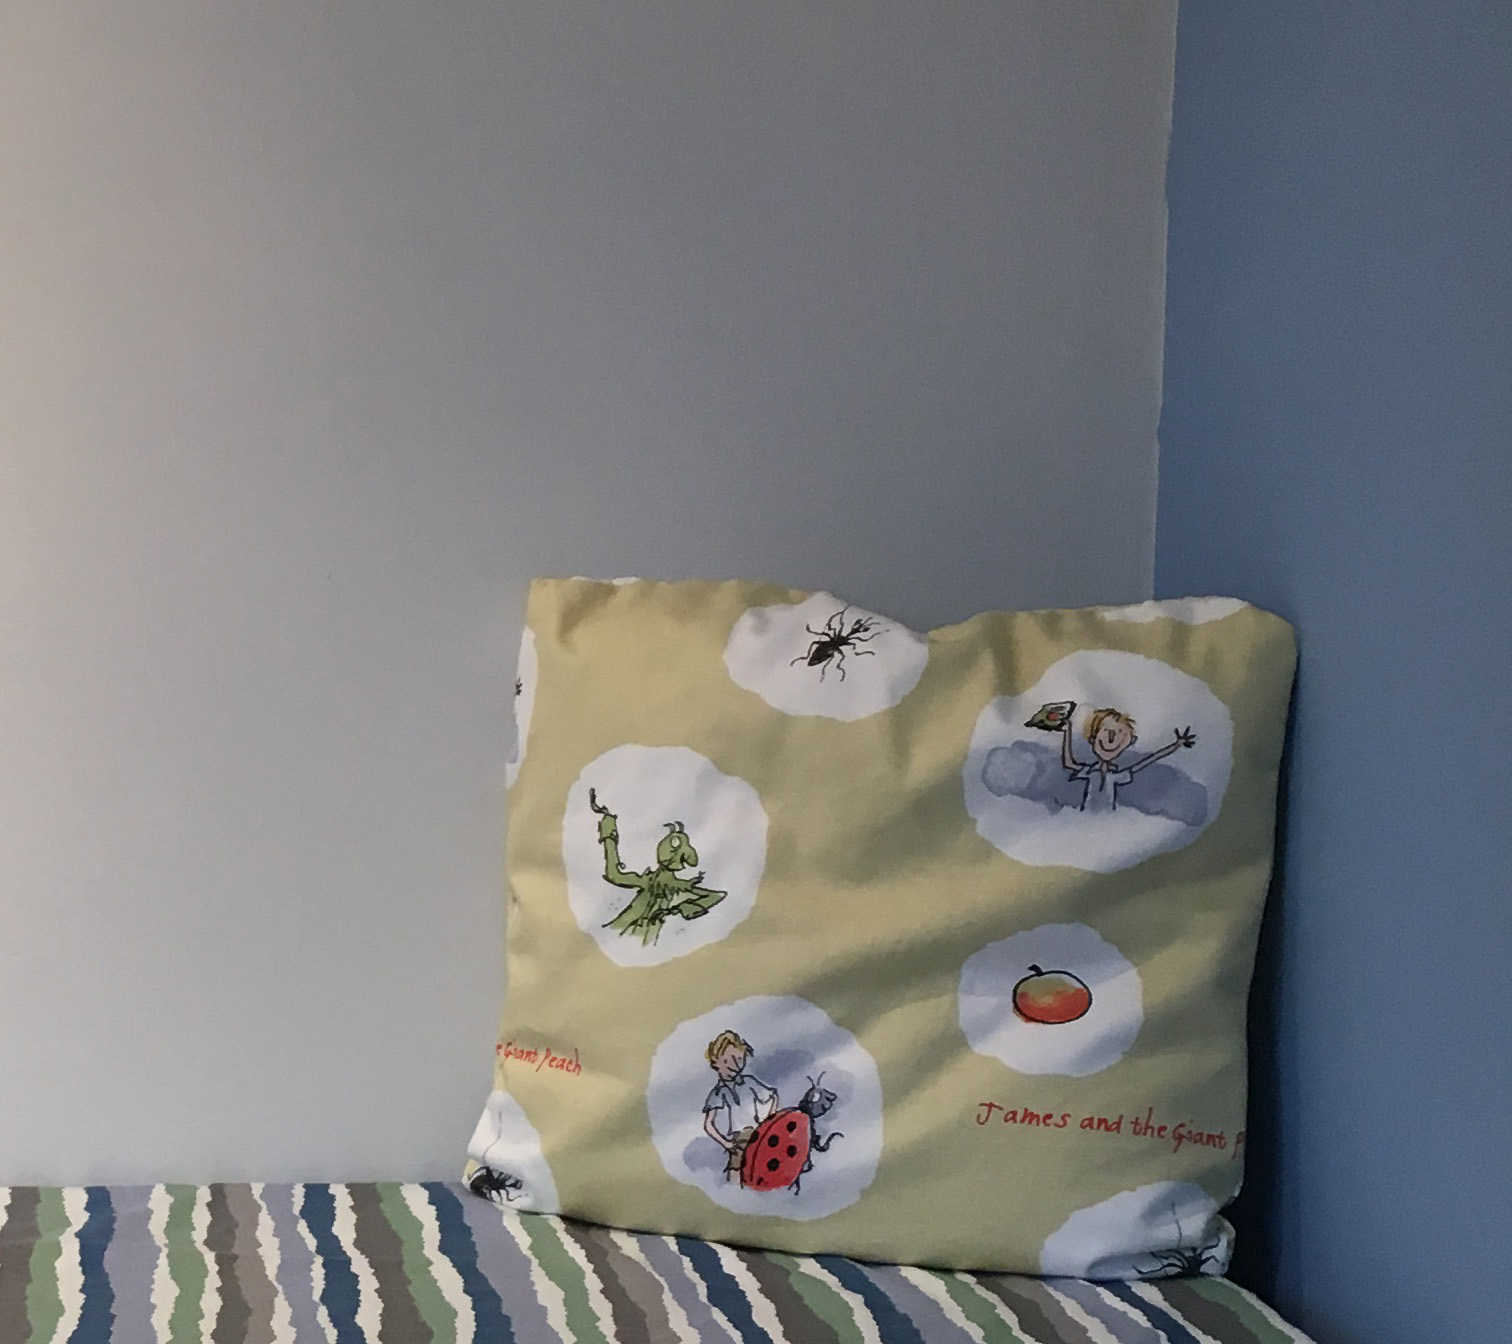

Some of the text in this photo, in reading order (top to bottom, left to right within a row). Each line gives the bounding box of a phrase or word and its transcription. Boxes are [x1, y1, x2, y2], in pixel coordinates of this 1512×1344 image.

[535, 1047, 582, 1076] Peach
[976, 1101, 1227, 1154] James and the Giant
